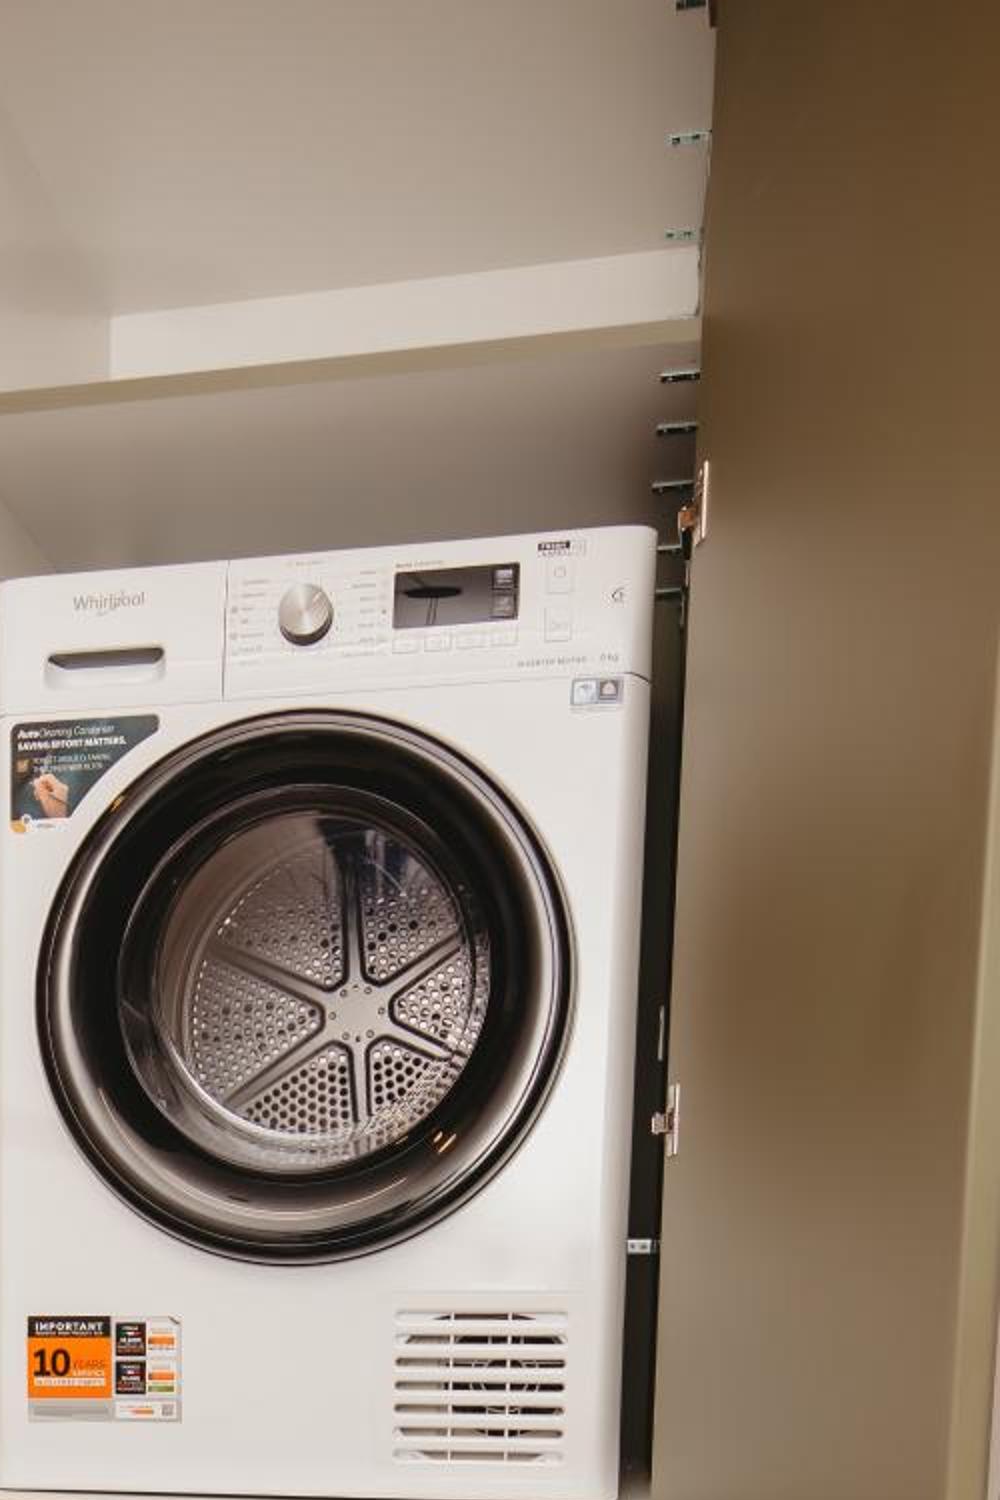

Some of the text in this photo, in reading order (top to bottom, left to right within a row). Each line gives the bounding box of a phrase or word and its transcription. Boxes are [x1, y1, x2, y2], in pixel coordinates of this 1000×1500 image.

[72, 588, 145, 617] Whirlpool
[35, 1321, 104, 1331] IMPORTANT
[33, 1348, 71, 1377] 10
